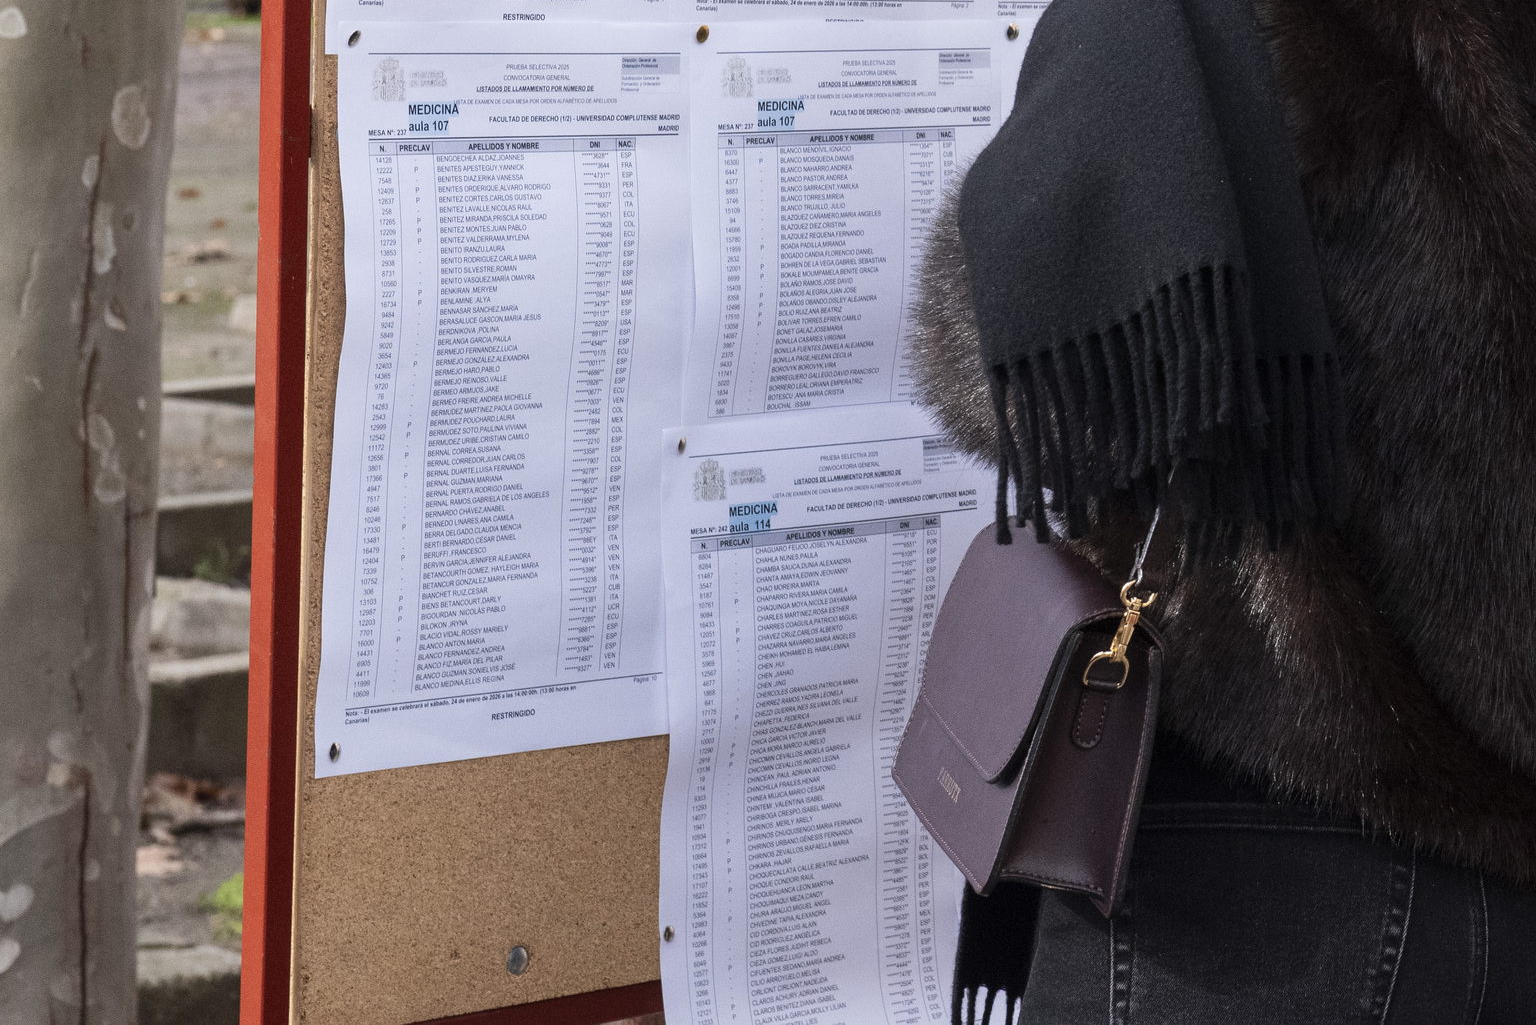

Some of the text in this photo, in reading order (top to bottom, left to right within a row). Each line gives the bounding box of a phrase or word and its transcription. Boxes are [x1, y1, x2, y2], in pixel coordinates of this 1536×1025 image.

[409, 104, 459, 115] MEDICINA
[758, 101, 804, 111] MEDICINA
[409, 120, 448, 132] aula 107
[758, 116, 794, 127] aula 107
[845, 134, 849, 142] Y
[399, 144, 430, 152] PRECLAV
[469, 142, 539, 151] APELLIDOS Y NOMBRE
[807, 504, 835, 512] FACULTAD
[846, 500, 872, 509] DERECHO
[888, 495, 921, 504] UNIVERSIDAD
[922, 491, 957, 501] COMPLUTENSE
[959, 489, 976, 497] MADRID
[729, 503, 777, 517] MEDICINA
[730, 520, 770, 532] aula 114
[786, 528, 855, 540] APELLIDOS Y NOMBRE
[720, 538, 750, 547] PRECLAV
[492, 709, 535, 720] RESTRINGIDO
